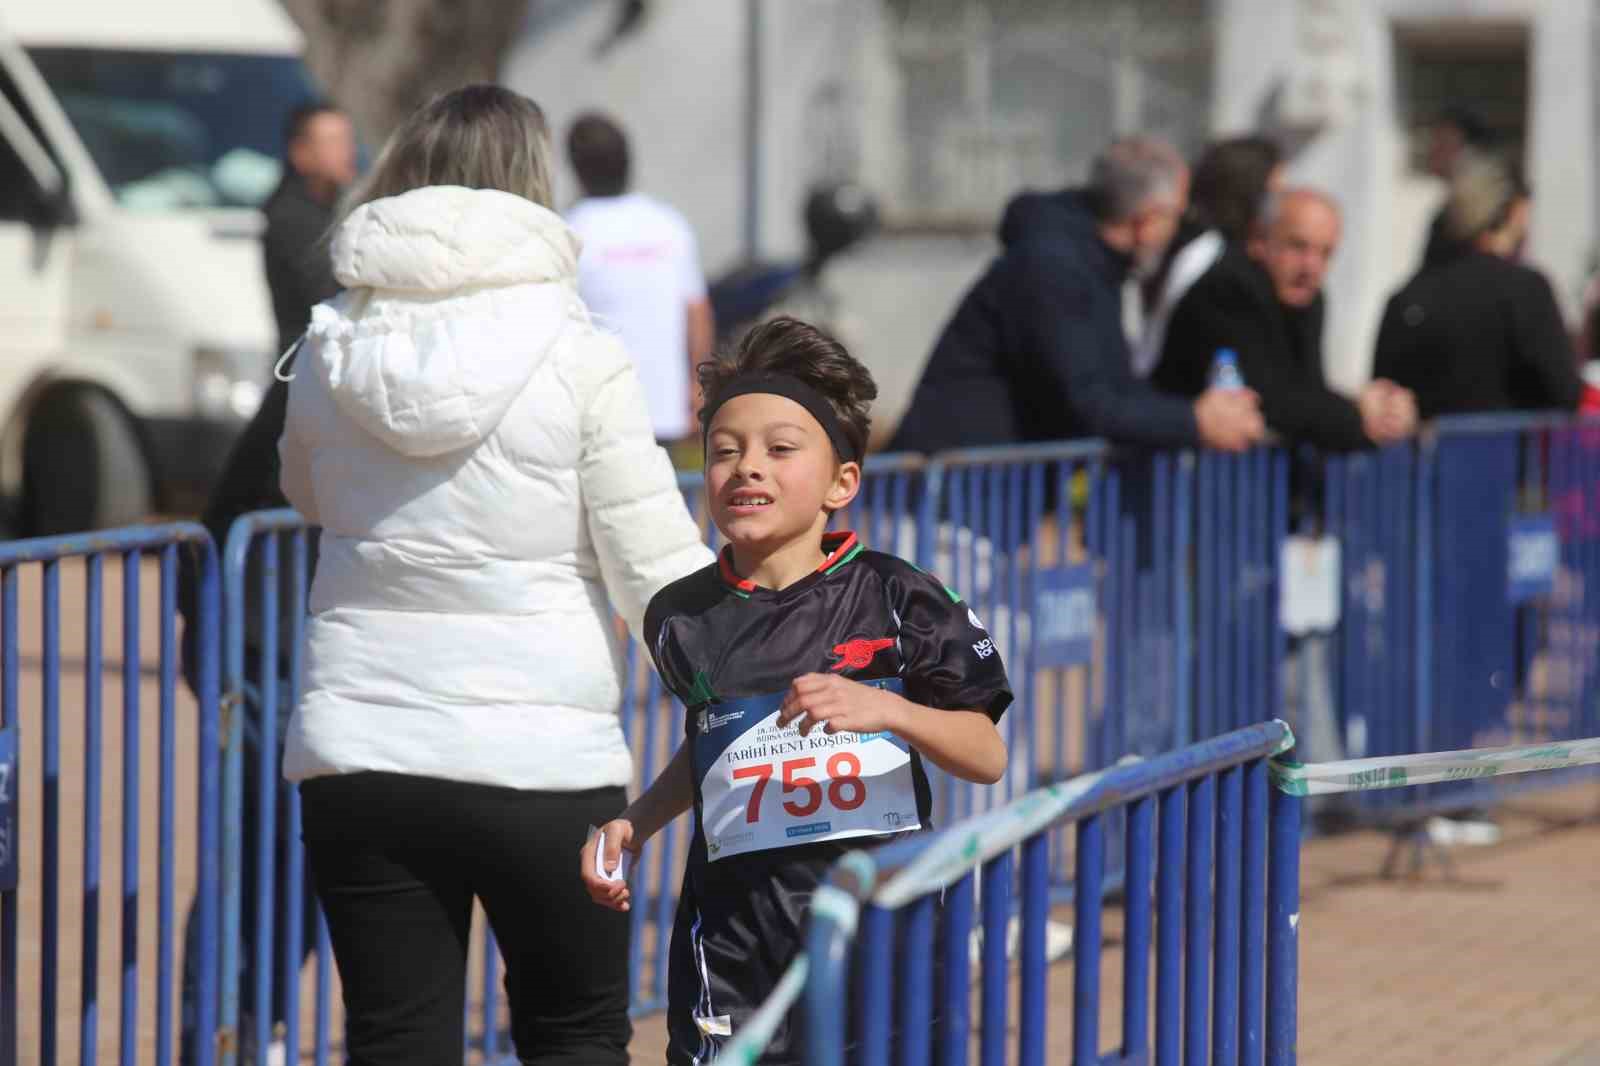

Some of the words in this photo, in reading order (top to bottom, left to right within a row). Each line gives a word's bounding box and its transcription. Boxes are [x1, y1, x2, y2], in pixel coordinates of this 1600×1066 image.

[727, 743, 767, 763] TARİHİ
[770, 740, 806, 756] KENT
[809, 733, 858, 749] KOŞUSU
[732, 751, 866, 824] 758
